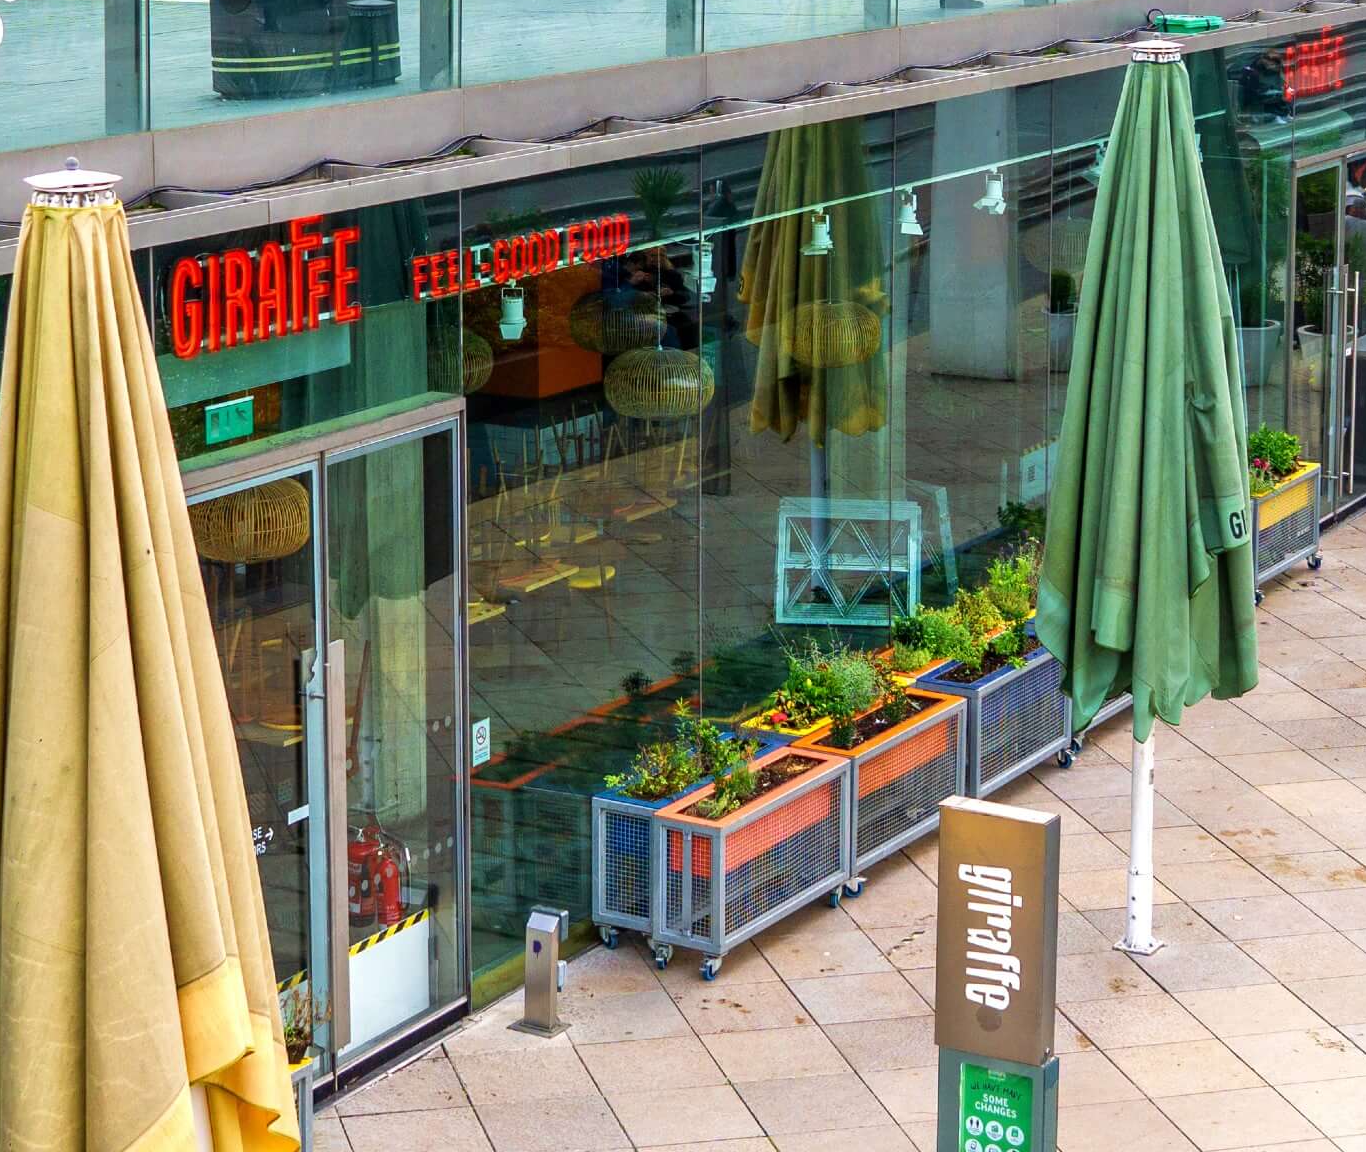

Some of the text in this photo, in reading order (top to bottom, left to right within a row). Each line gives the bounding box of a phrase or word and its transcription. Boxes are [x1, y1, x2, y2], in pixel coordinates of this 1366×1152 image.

[171, 214, 362, 361] GIRAFFE
[412, 212, 631, 304] FEEL-GOOD FOOD
[958, 863, 1023, 1010] giraffe
[974, 1101, 1017, 1118] CHANGES
[982, 1093, 1009, 1108] SOME
